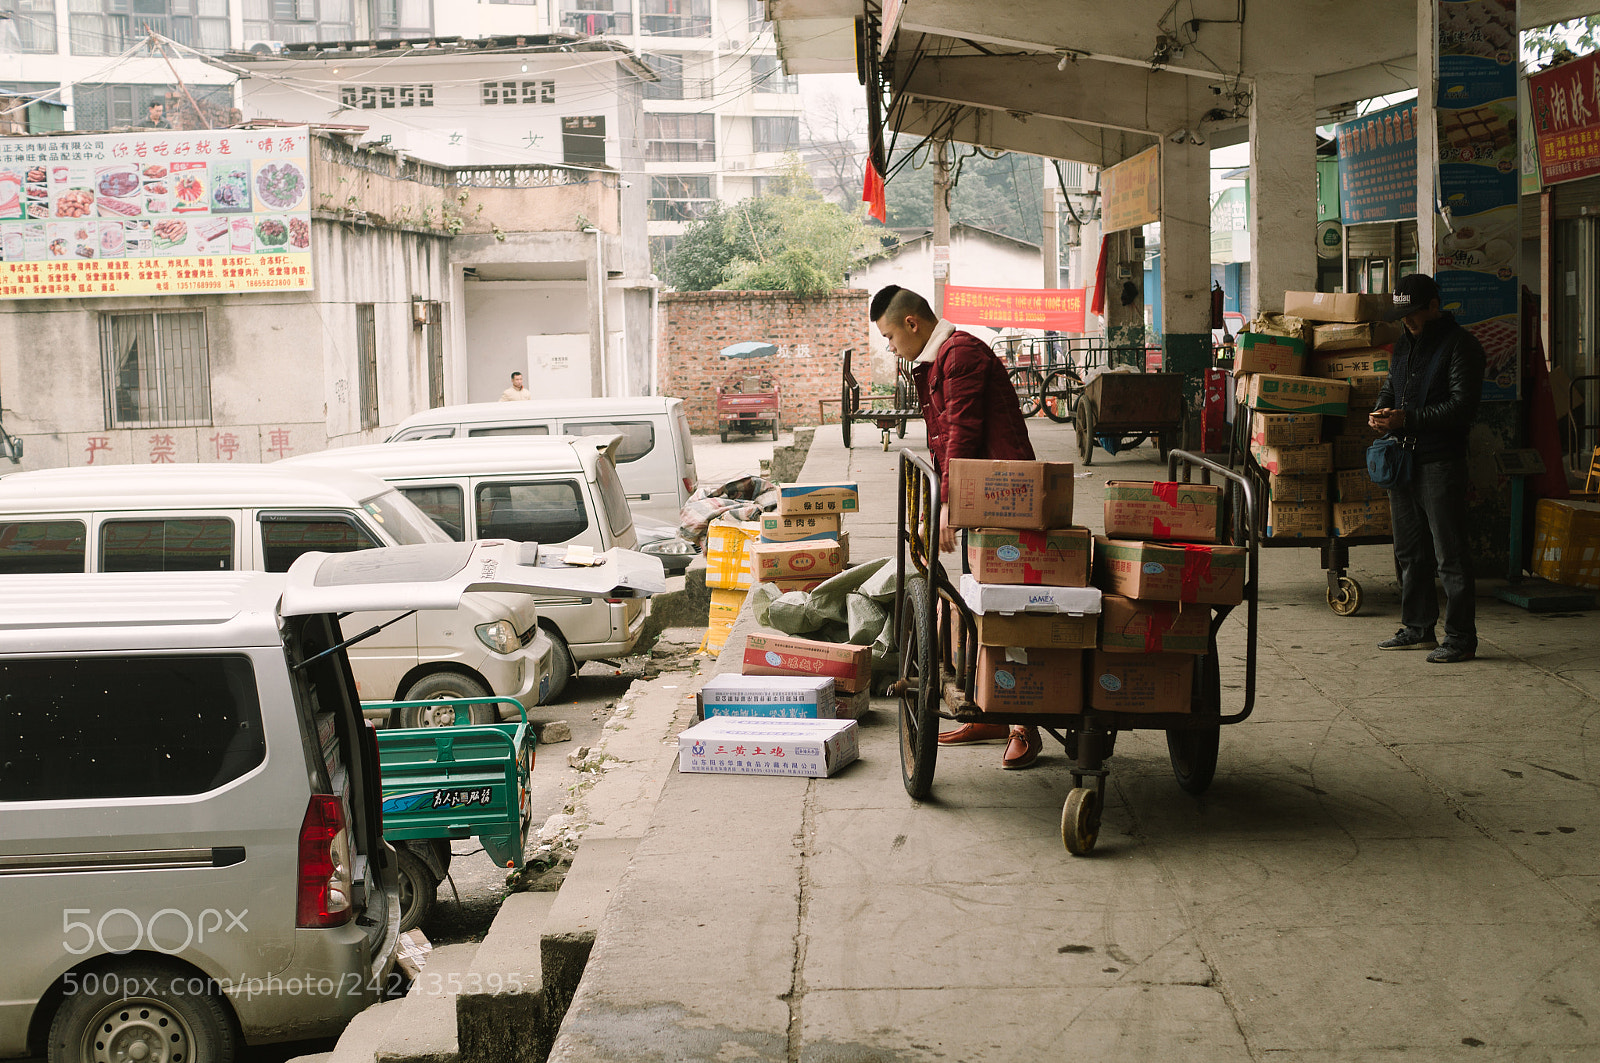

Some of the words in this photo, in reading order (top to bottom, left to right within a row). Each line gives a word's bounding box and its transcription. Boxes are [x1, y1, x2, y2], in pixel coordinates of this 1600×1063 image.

[0, 141, 104, 153] 正天肉制品有限公司
[783, 517, 816, 528] 鱼肉卷
[1029, 595, 1054, 603] LAMEX
[714, 745, 786, 758] 三黄土鸡
